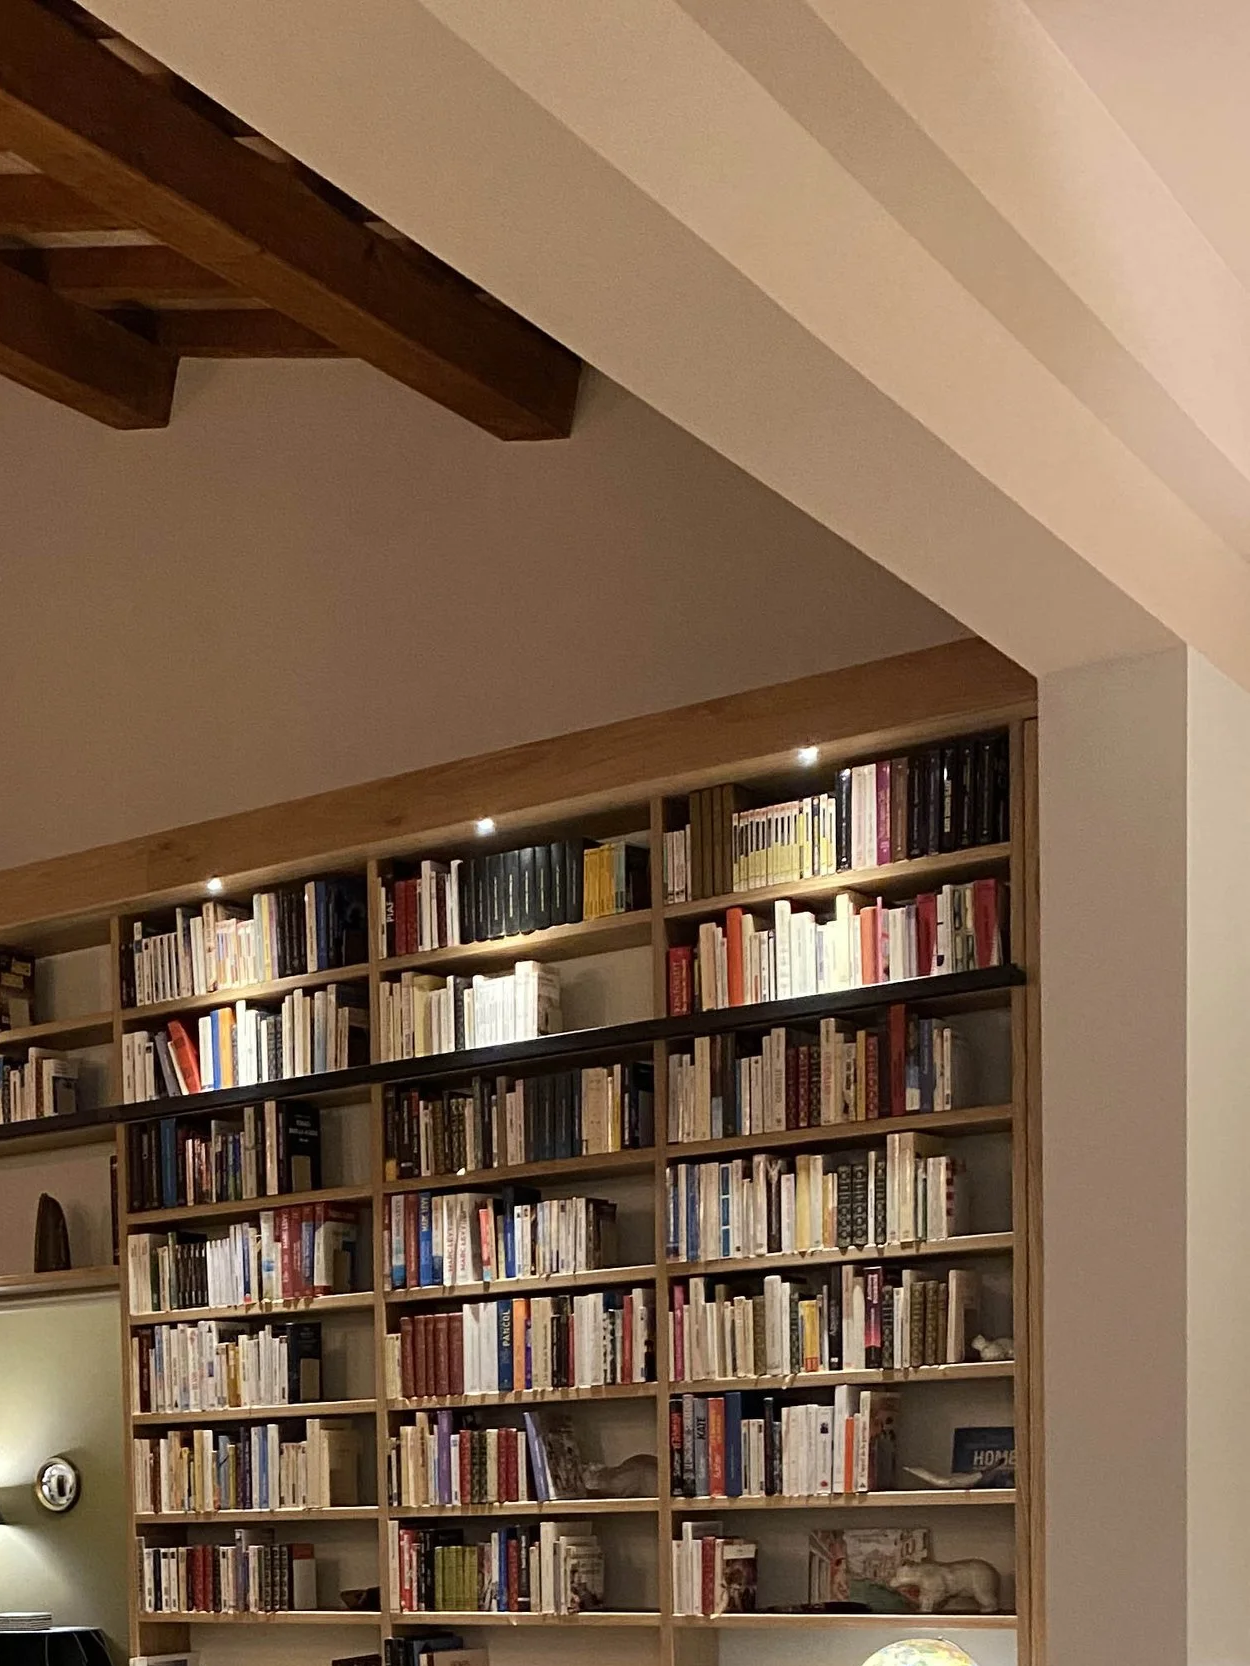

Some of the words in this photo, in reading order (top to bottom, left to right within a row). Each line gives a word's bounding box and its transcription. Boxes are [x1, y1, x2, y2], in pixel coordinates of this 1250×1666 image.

[502, 1309, 510, 1347] PANCOL
[696, 1416, 706, 1440] KATE
[973, 1449, 1015, 1466] HOME
